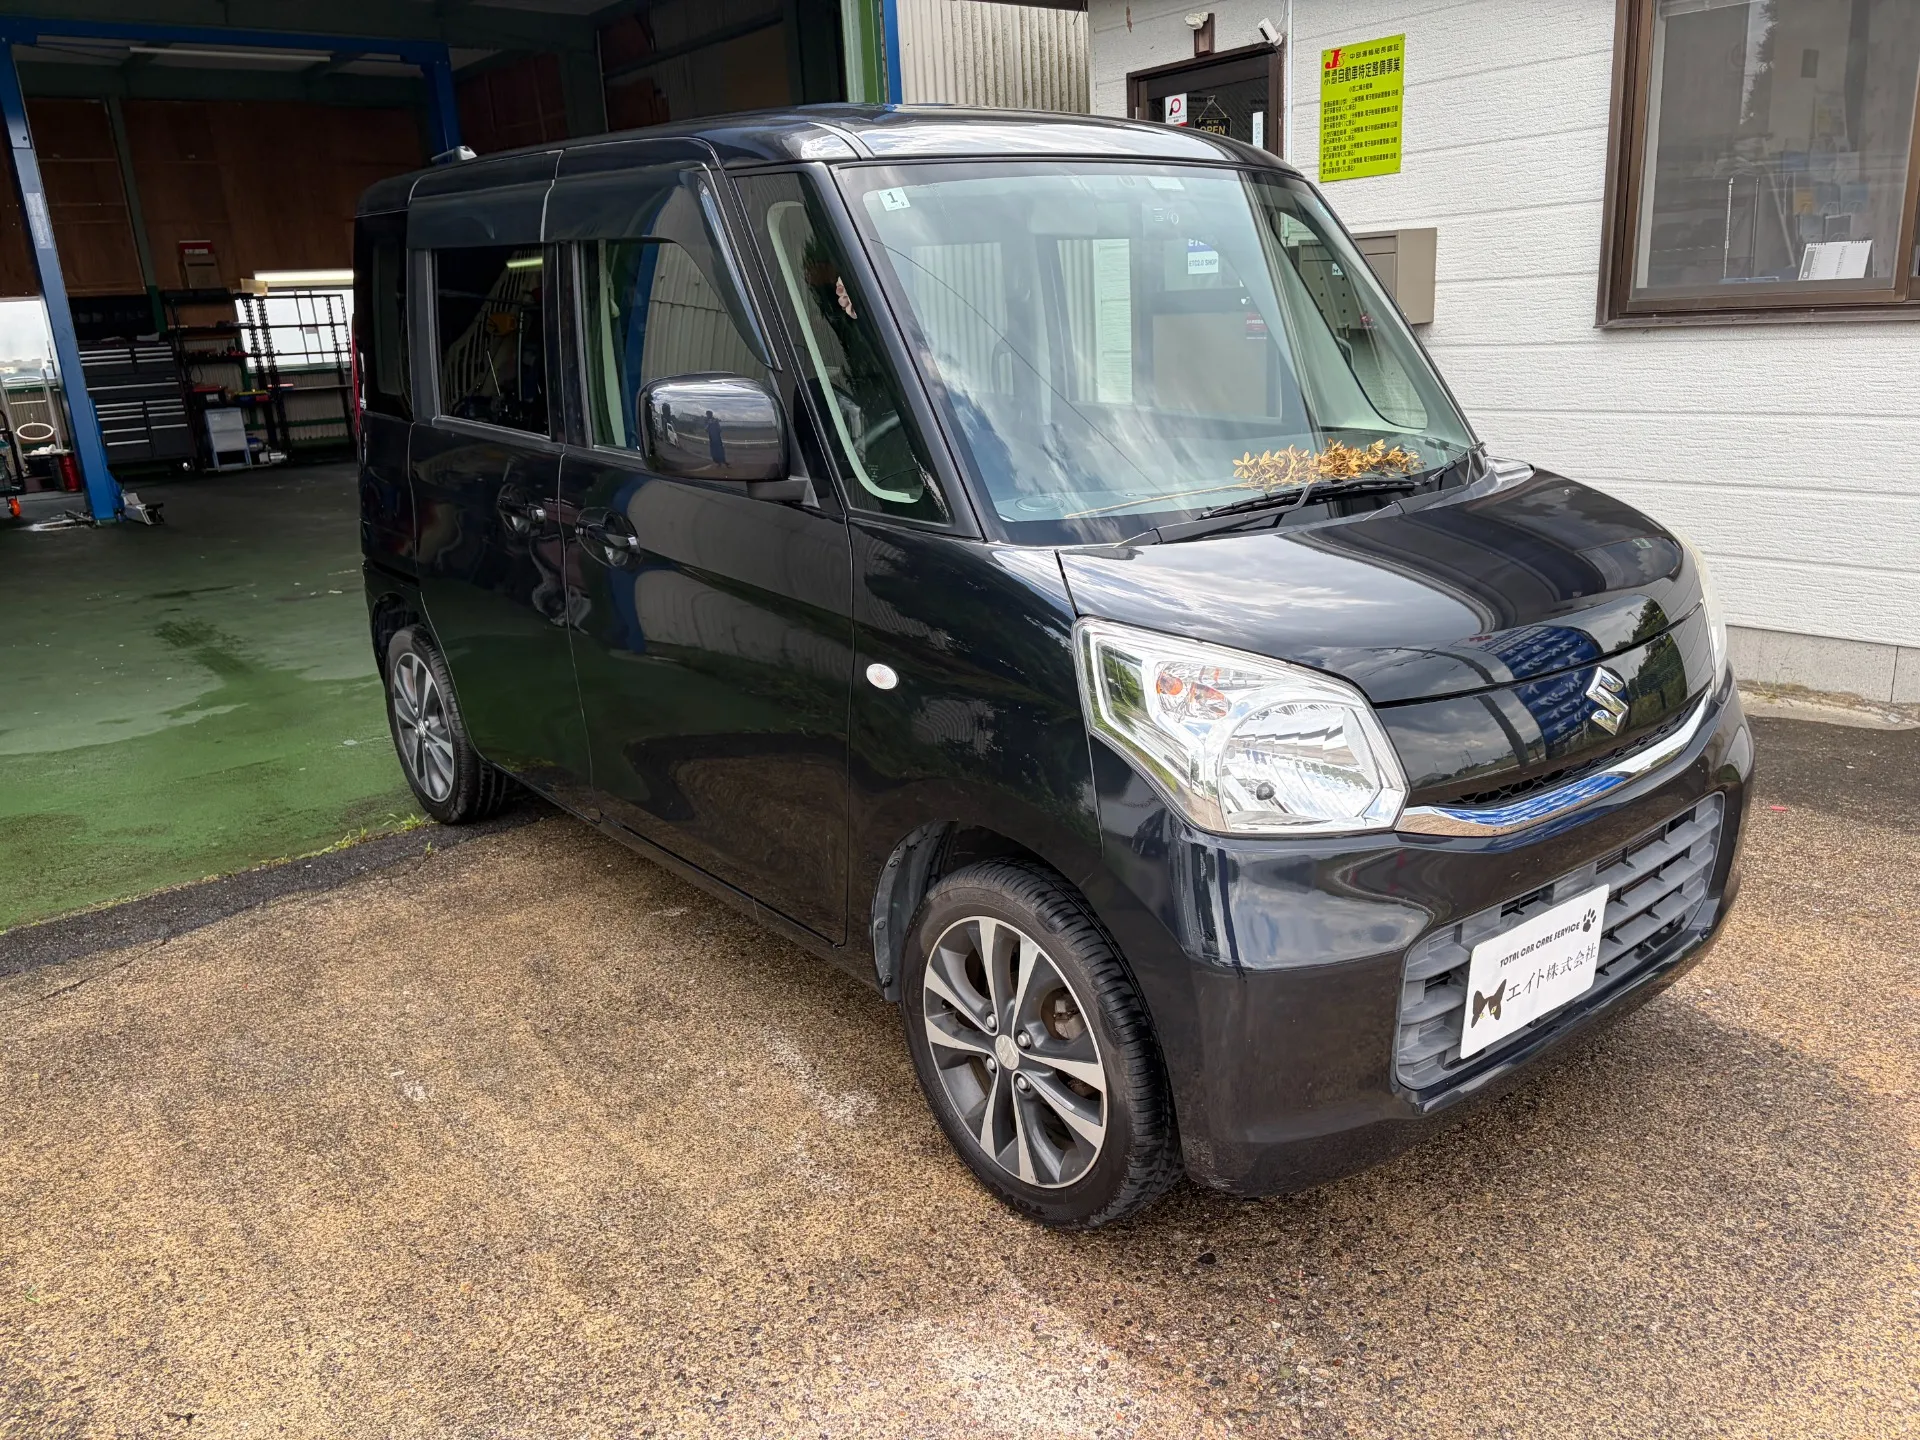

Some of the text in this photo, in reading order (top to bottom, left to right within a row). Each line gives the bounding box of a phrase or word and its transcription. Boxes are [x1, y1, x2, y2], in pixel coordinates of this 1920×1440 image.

[887, 192, 898, 203] 1
[1500, 922, 1580, 967] TOTAL CAR CARE SERVICE
[1506, 942, 1597, 1002] エイト株式会社
